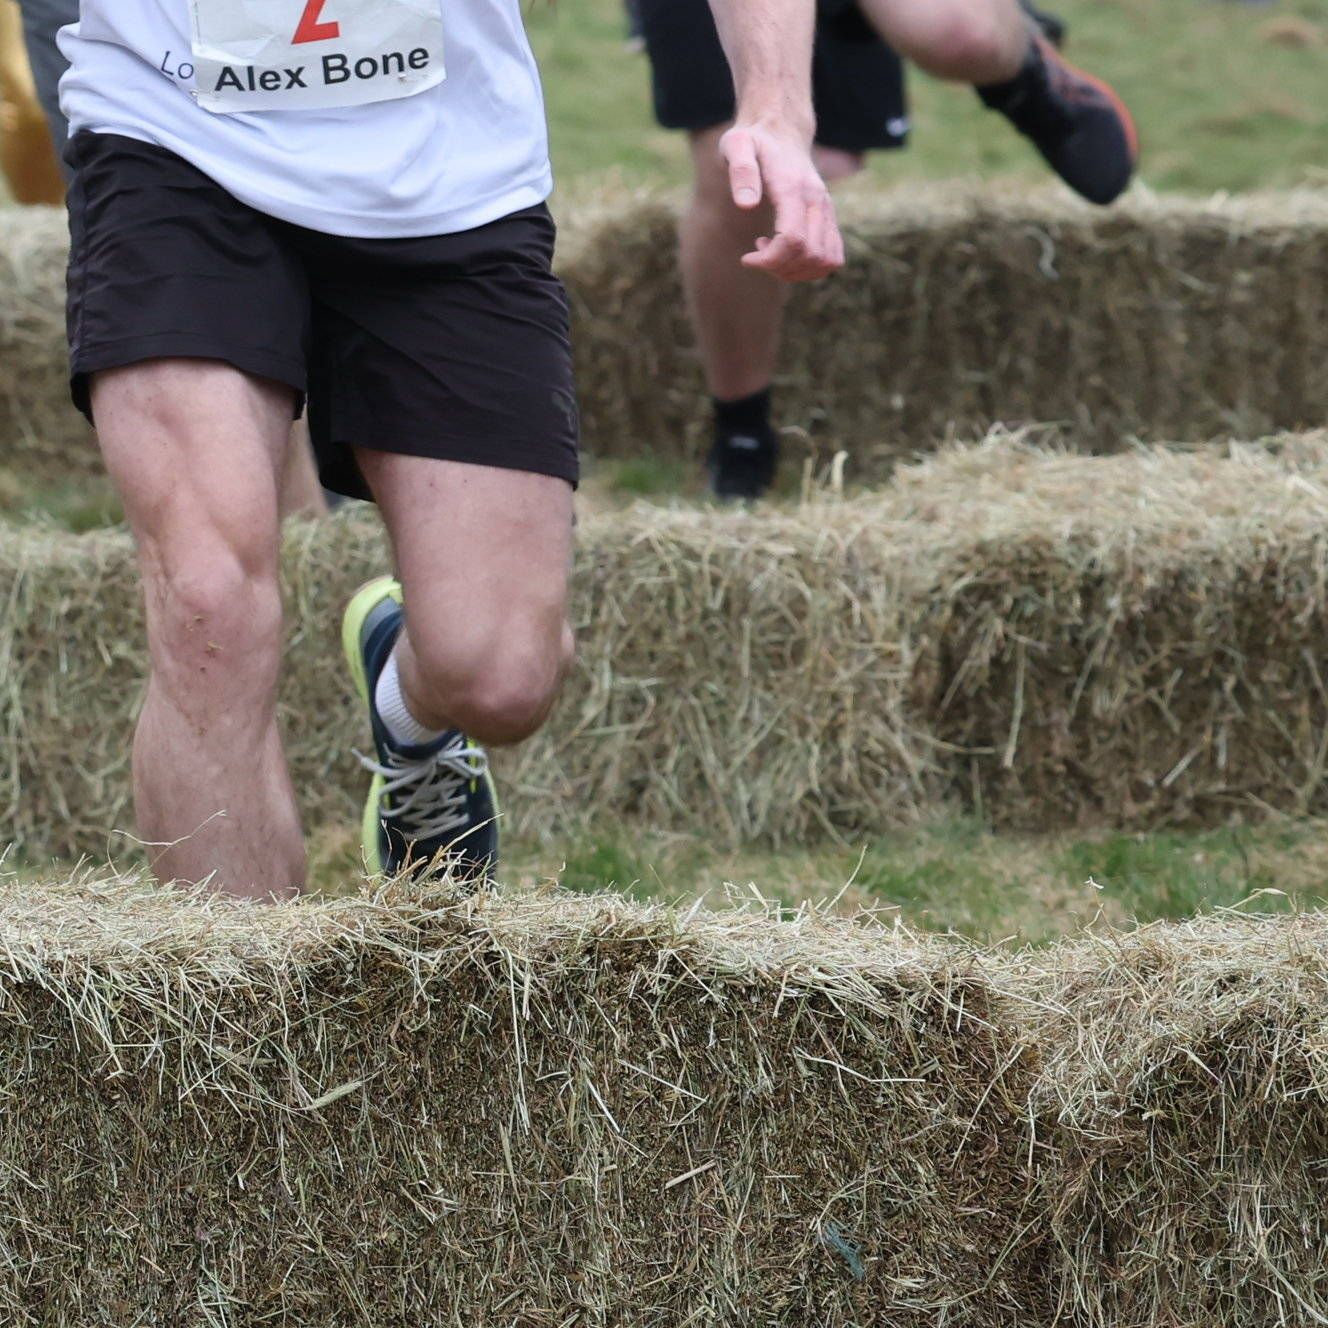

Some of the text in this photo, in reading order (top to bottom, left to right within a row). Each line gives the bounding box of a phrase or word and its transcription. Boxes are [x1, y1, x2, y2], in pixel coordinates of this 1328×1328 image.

[161, 50, 194, 80] Lo
[214, 47, 430, 92] Alex Bone
